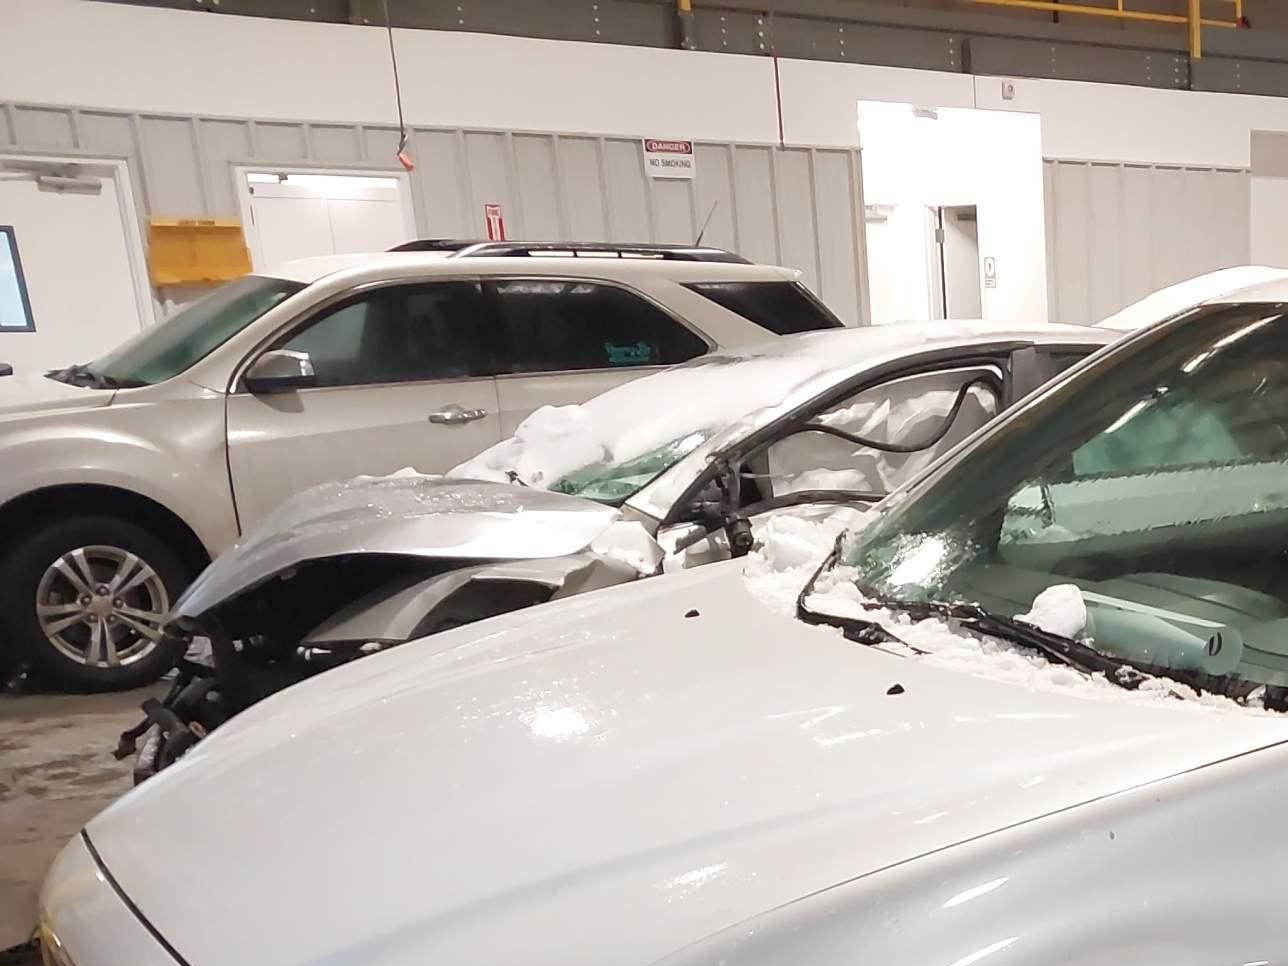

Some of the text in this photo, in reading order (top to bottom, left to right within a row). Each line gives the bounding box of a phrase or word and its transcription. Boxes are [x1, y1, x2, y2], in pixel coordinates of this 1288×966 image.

[651, 142, 686, 151] DANGER
[649, 158, 692, 168] NO SMOKING
